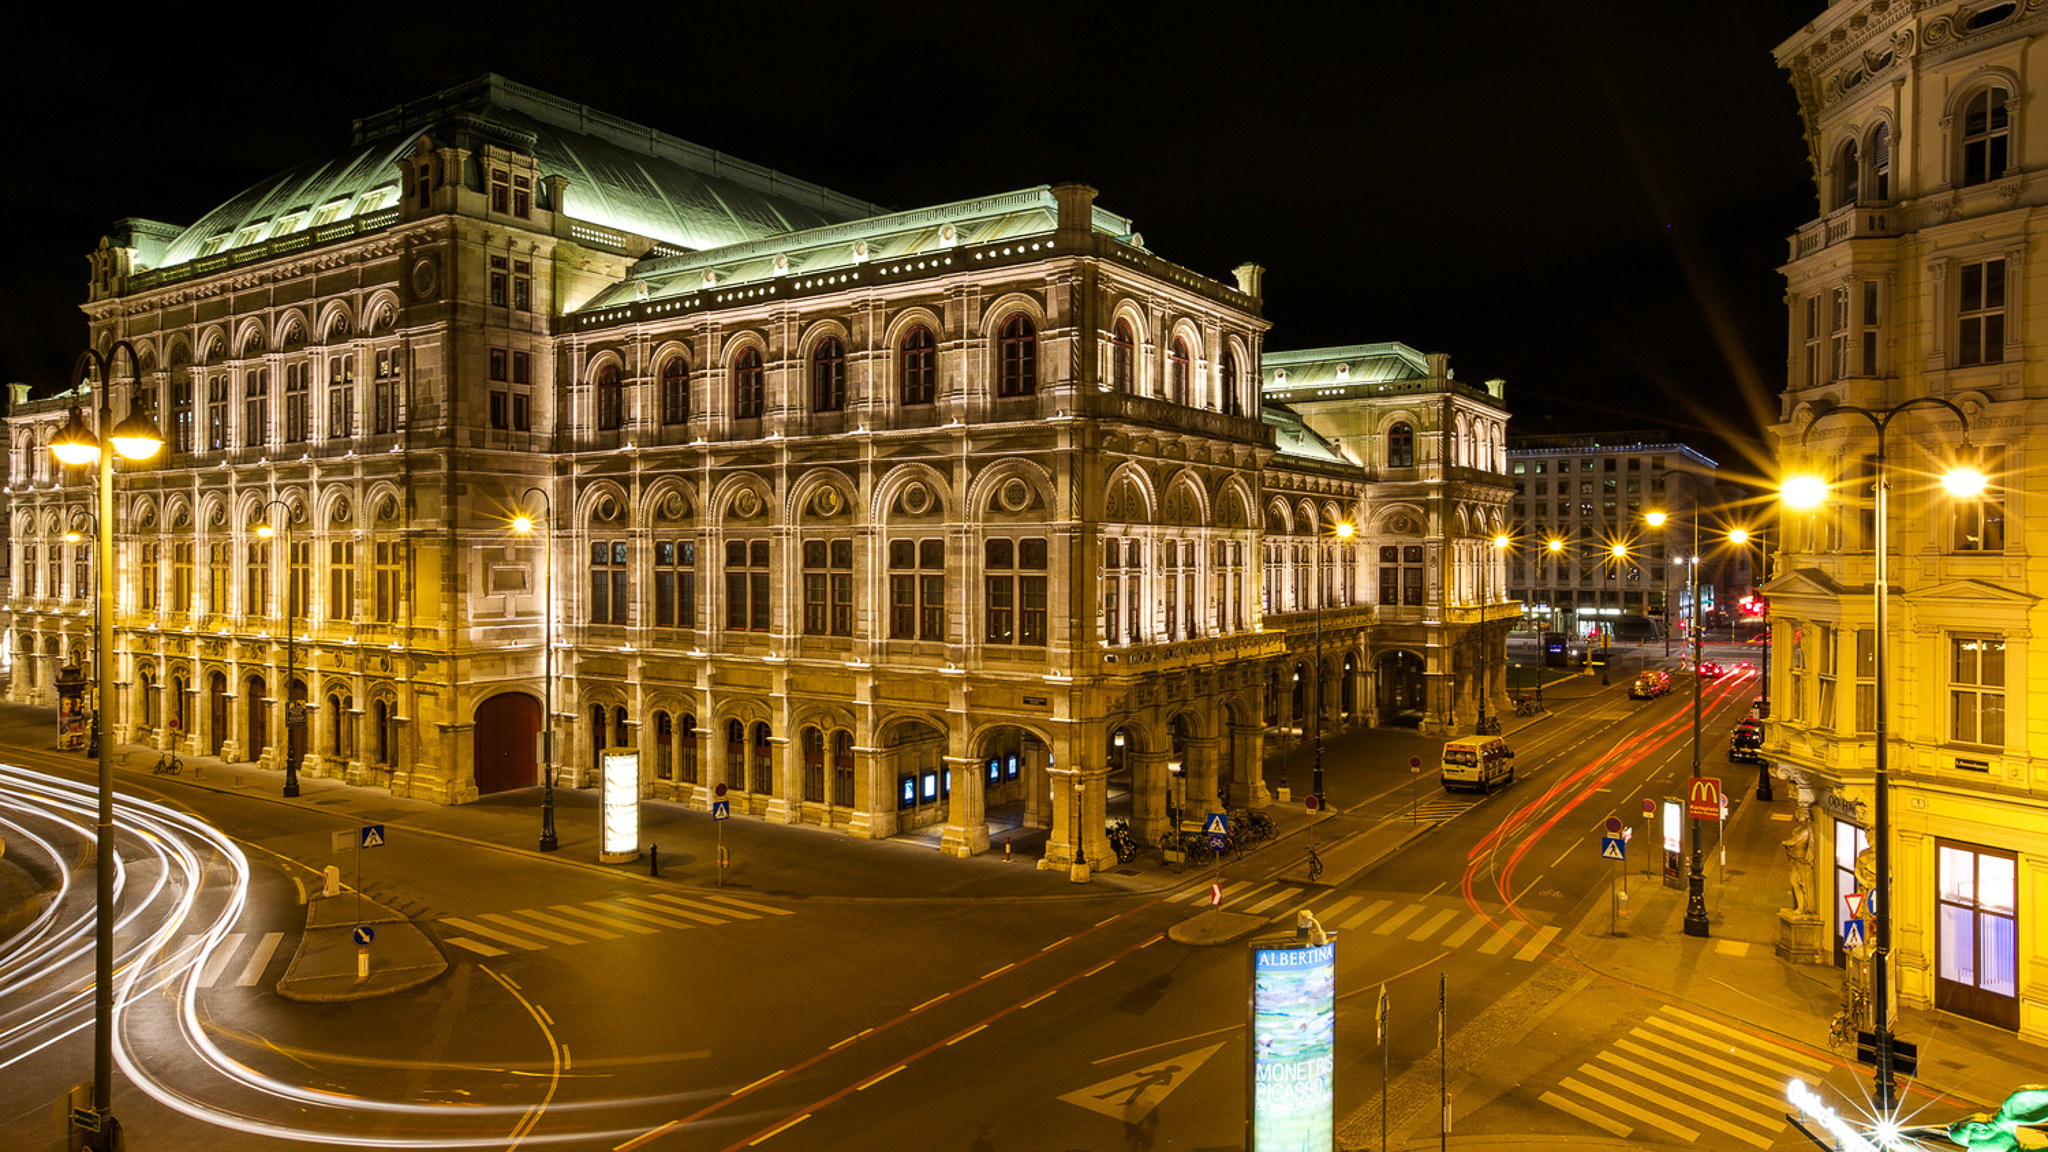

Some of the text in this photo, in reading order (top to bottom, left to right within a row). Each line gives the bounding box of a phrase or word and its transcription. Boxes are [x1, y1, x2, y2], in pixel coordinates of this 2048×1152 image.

[1258, 947, 1333, 966] ALBERTINA
[1256, 1054, 1334, 1083] MONET BIS
[1256, 1078, 1323, 1102] PICASSO
